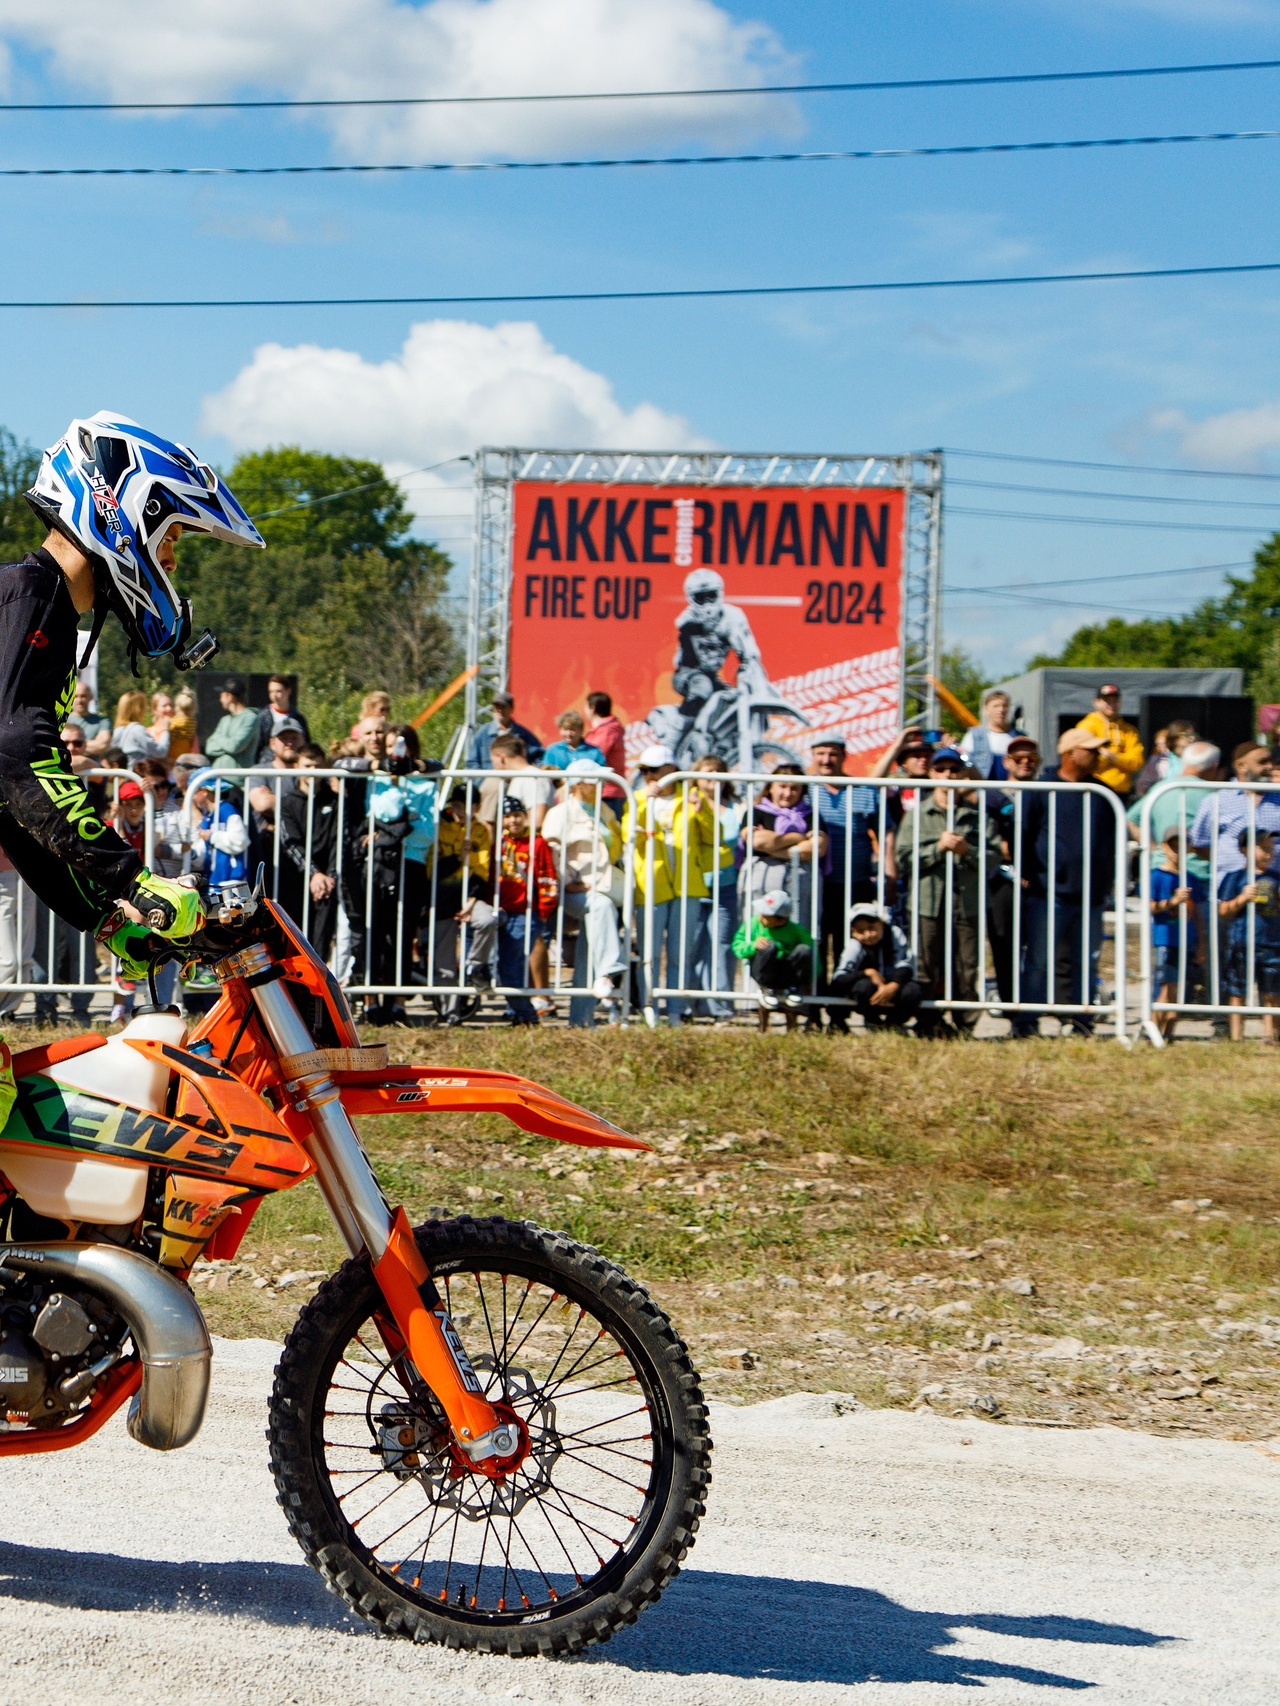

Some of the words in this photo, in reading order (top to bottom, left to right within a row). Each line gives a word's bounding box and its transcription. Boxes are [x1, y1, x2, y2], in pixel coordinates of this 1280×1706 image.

[91, 475, 123, 533] HIZER
[526, 496, 891, 568] AKKERMANN
[674, 498, 696, 566] cement
[524, 574, 587, 618] FIRE
[593, 576, 651, 620] CUP
[804, 580, 885, 625] 2024
